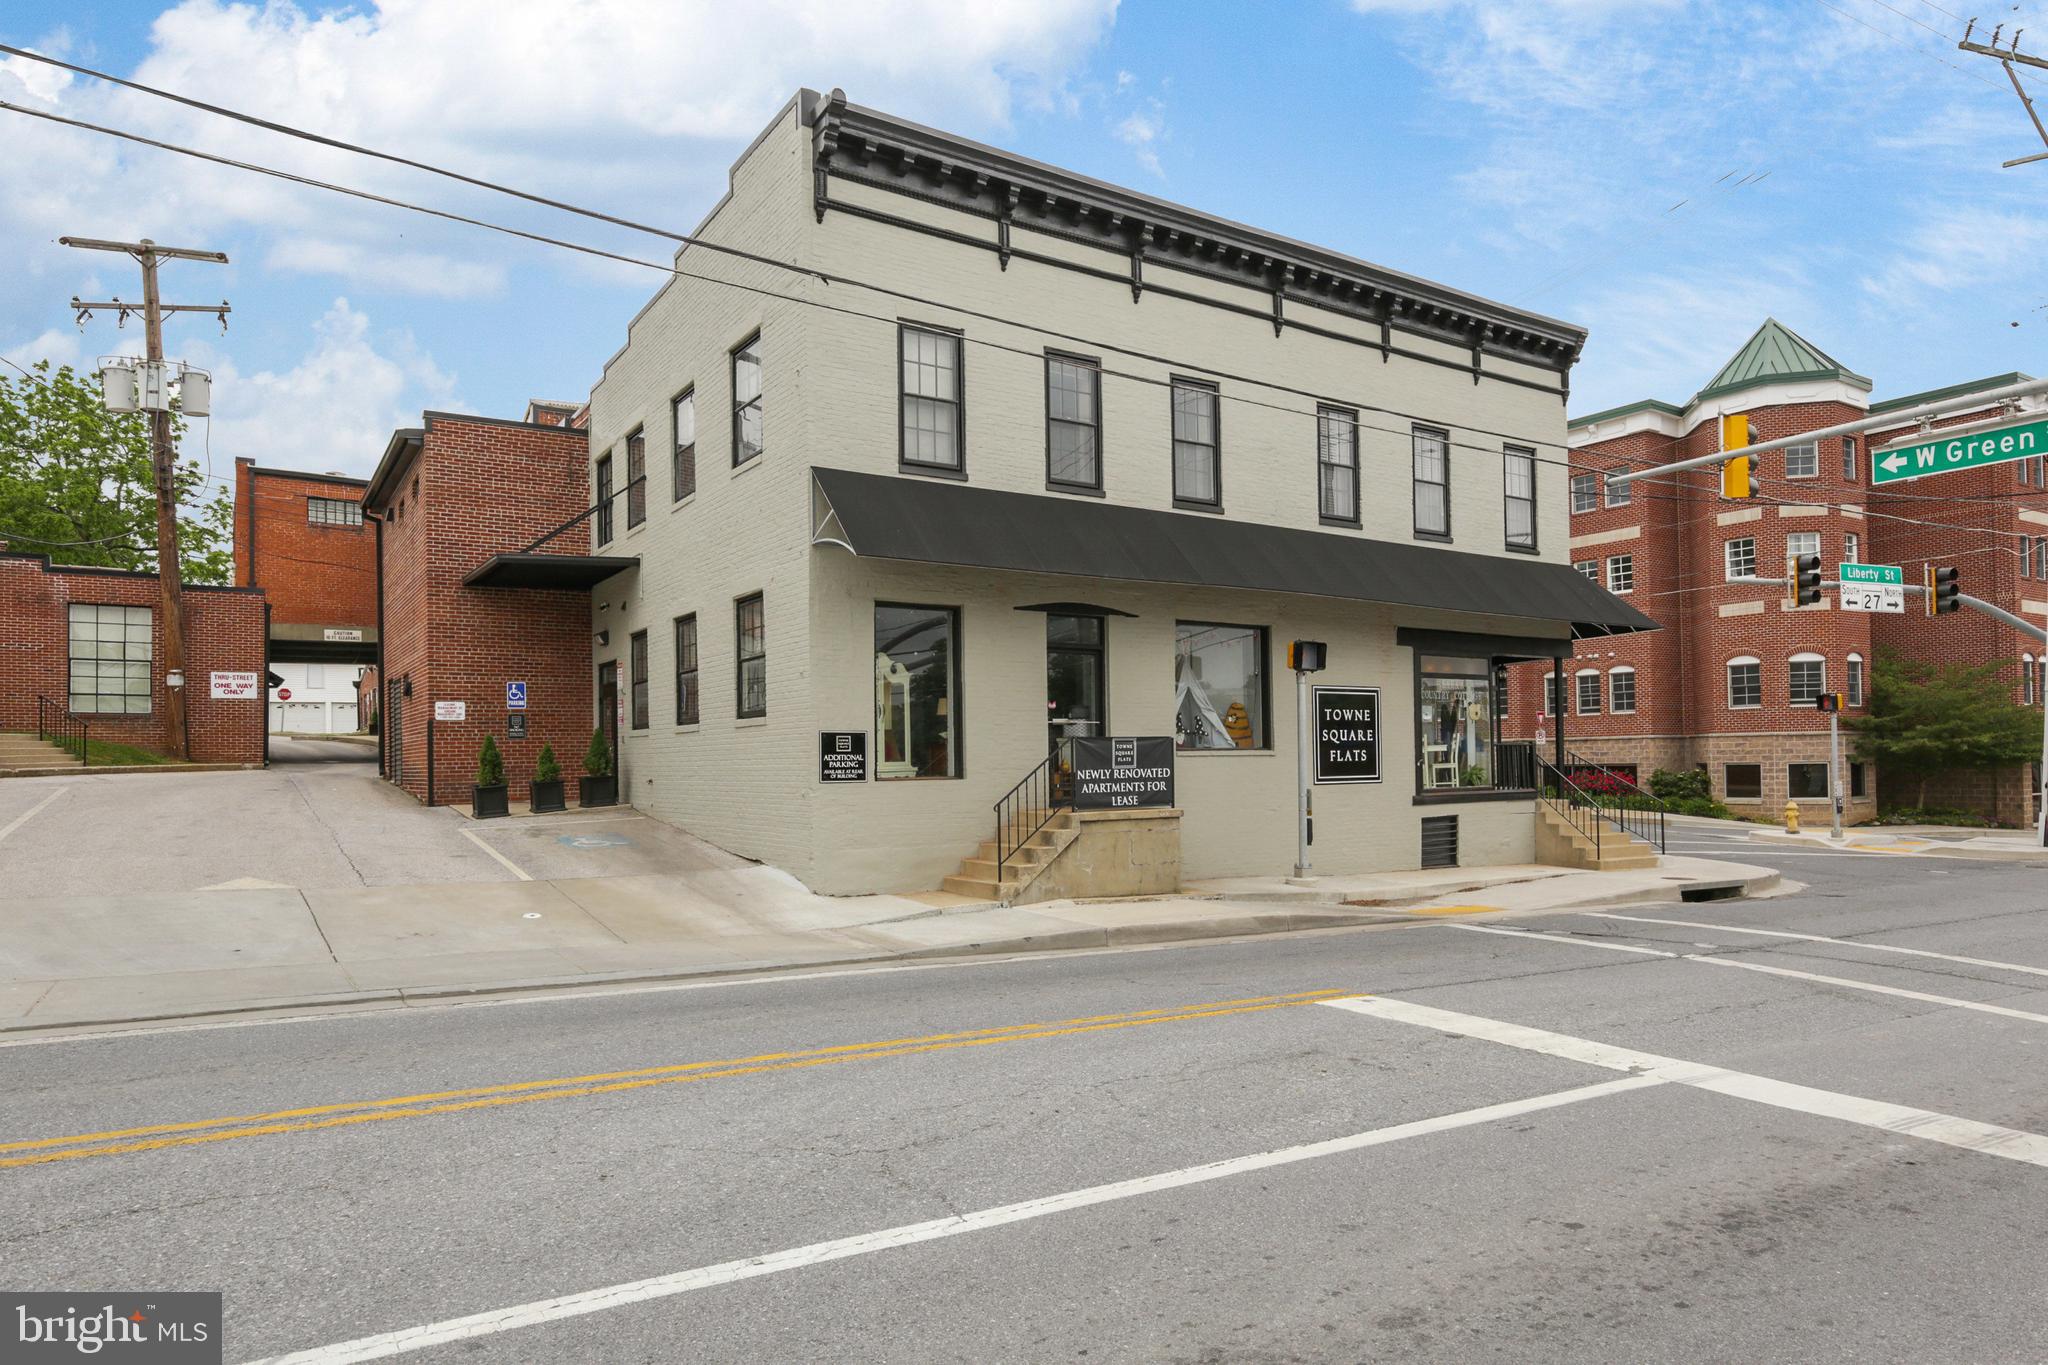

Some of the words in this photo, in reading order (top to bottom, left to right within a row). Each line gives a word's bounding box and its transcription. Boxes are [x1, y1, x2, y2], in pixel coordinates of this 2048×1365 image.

[1915, 445, 1936, 468] W
[1946, 431, 2035, 462] Green
[1847, 567, 1879, 582] Liberty
[1884, 569, 1895, 581] St
[1864, 594, 1881, 609] 27
[1324, 708, 1371, 721] TOWNE
[1322, 729, 1374, 743] SQUARE
[1329, 749, 1367, 762] FLATS
[1077, 769, 1111, 780] NEWLY
[1113, 768, 1171, 779] RENOVATED
[1081, 782, 1145, 793] APARTMENTS
[1147, 781, 1167, 791] FOR
[1112, 795, 1139, 806] LEASE
